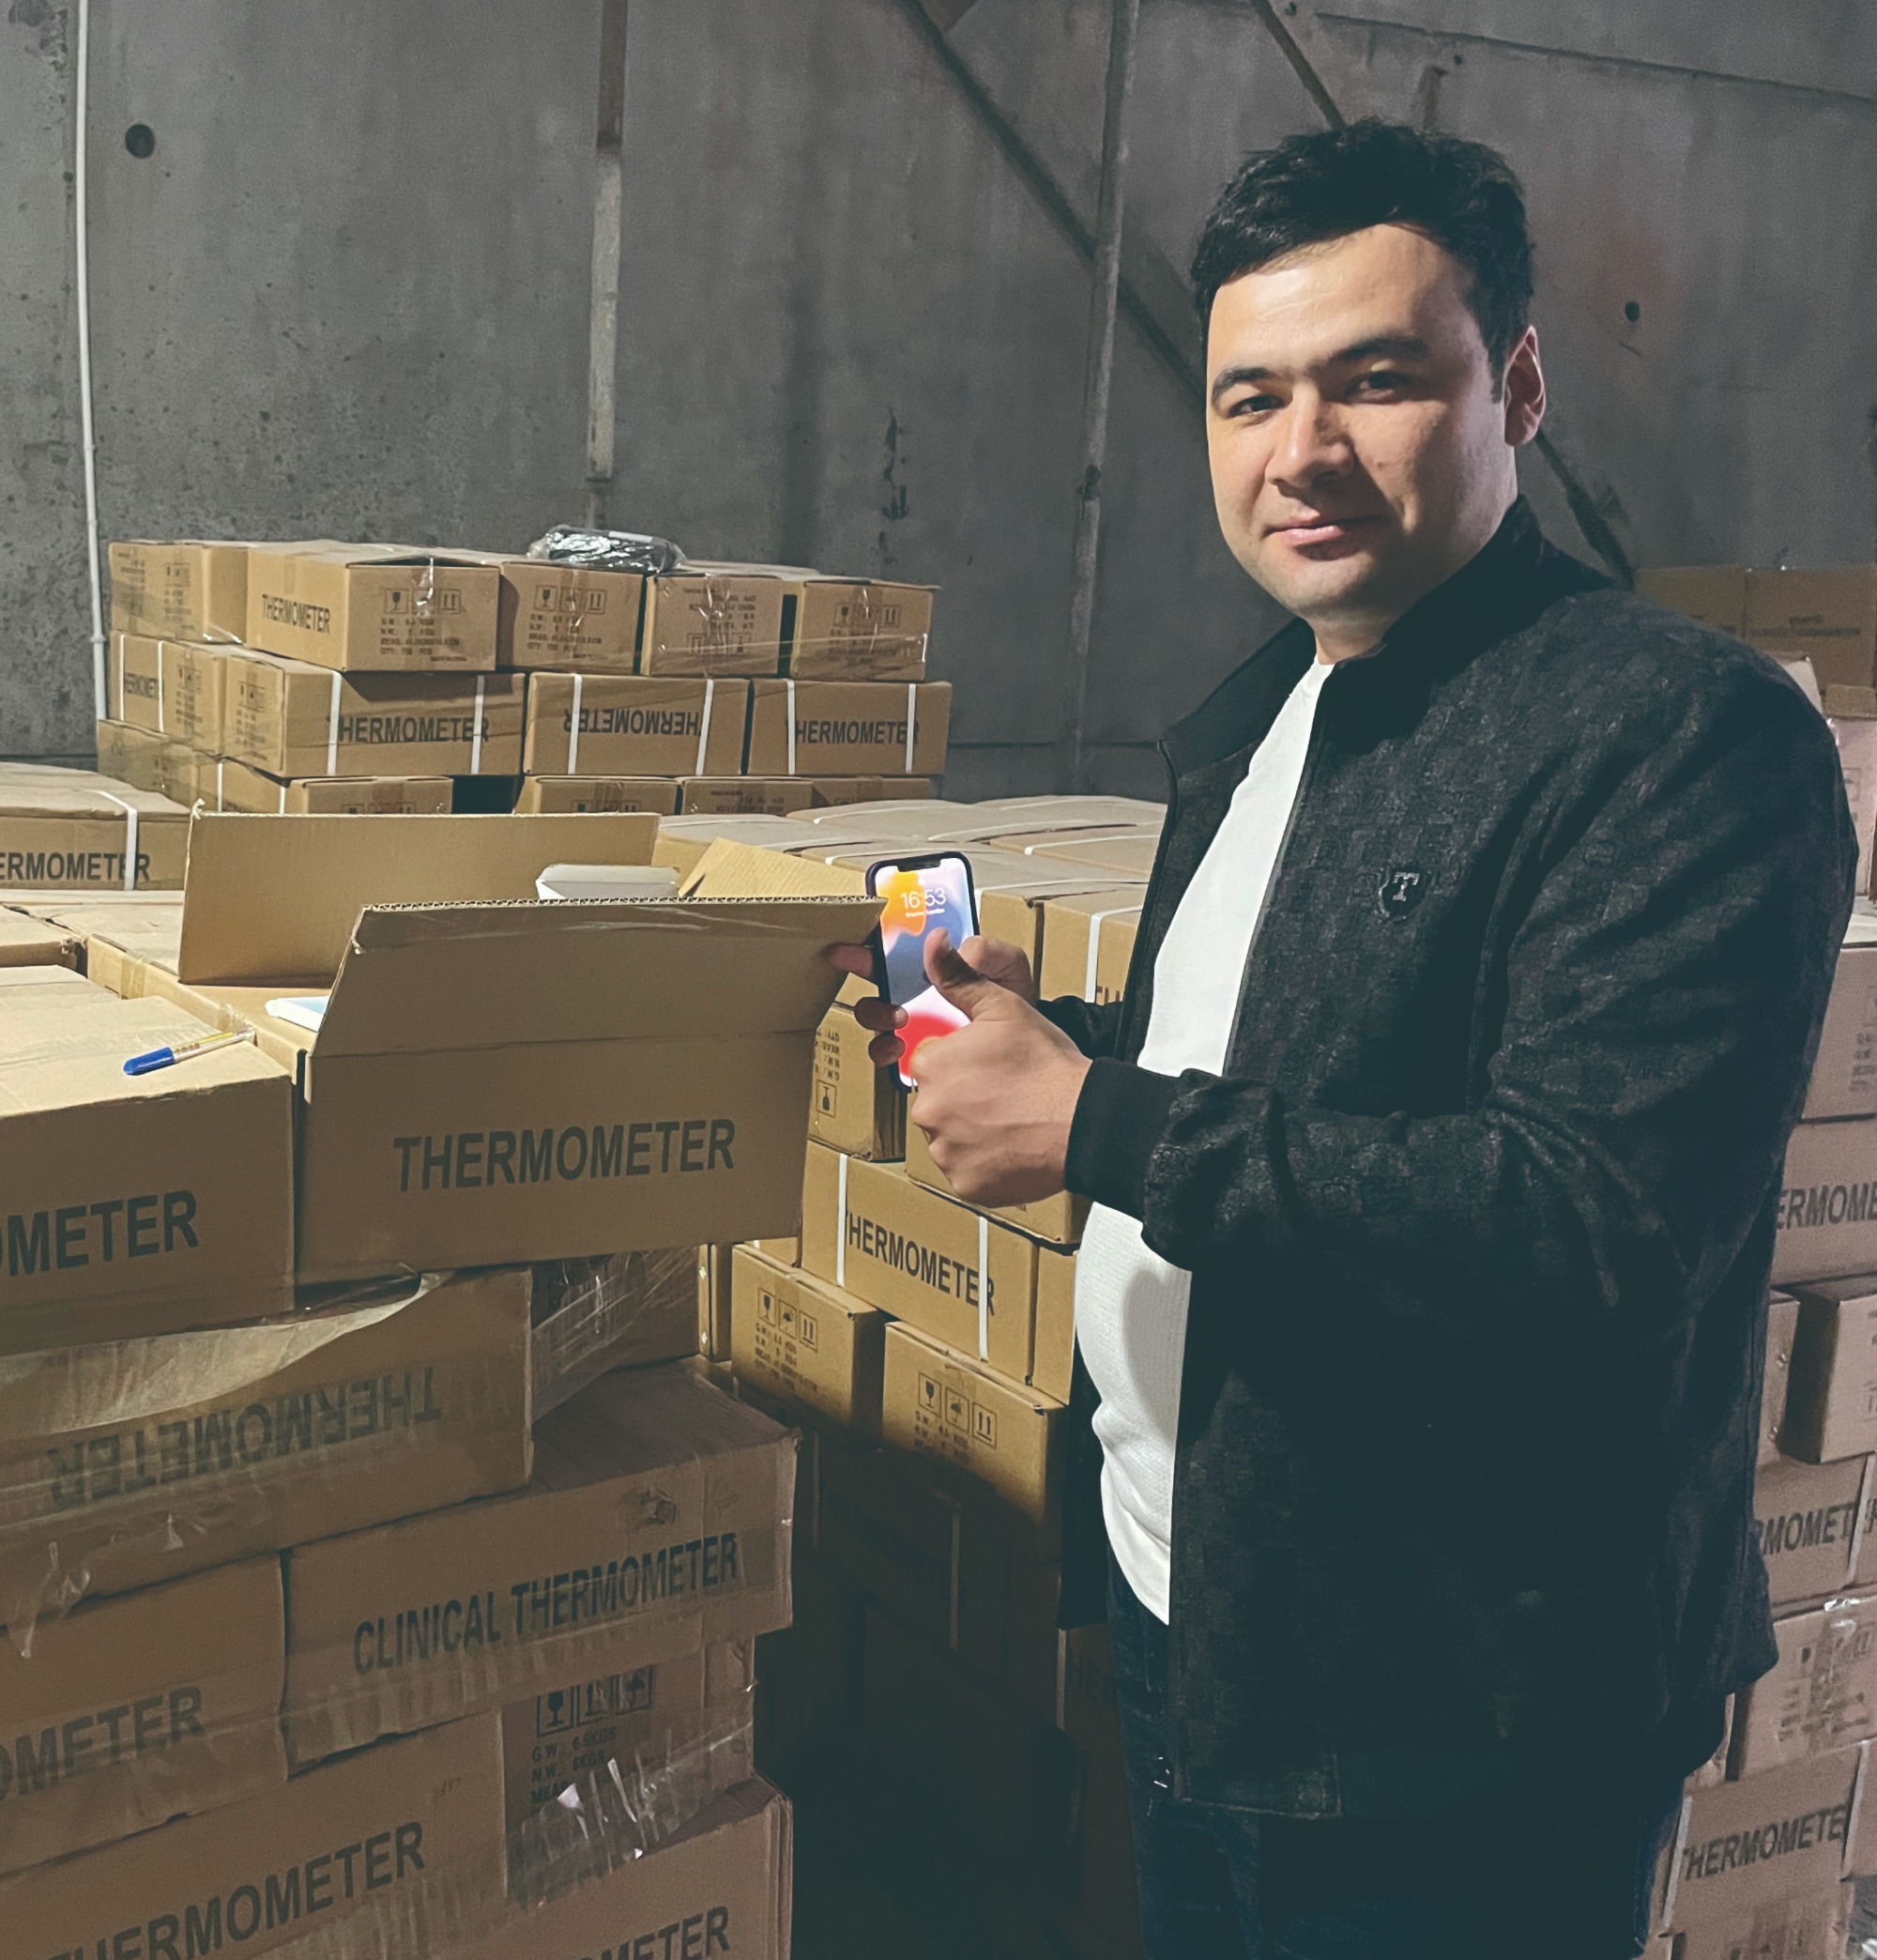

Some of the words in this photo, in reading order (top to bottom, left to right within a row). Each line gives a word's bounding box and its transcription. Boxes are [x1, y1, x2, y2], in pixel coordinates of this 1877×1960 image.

[262, 593, 330, 635] THERMOMETER
[327, 716, 490, 743] HERMOMETER
[564, 708, 702, 736] HERMOMETER
[1392, 871, 1420, 901] T
[393, 1118, 736, 1192] THERMOMETER
[0, 1189, 200, 1277] METER
[846, 1209, 995, 1316] HERMOMETER
[46, 1366, 442, 1506] THERMOMETER
[354, 1591, 501, 1676] CLINICAL
[511, 1532, 739, 1635] THERMOMETER
[1684, 1804, 1847, 1880] HERMOMETE
